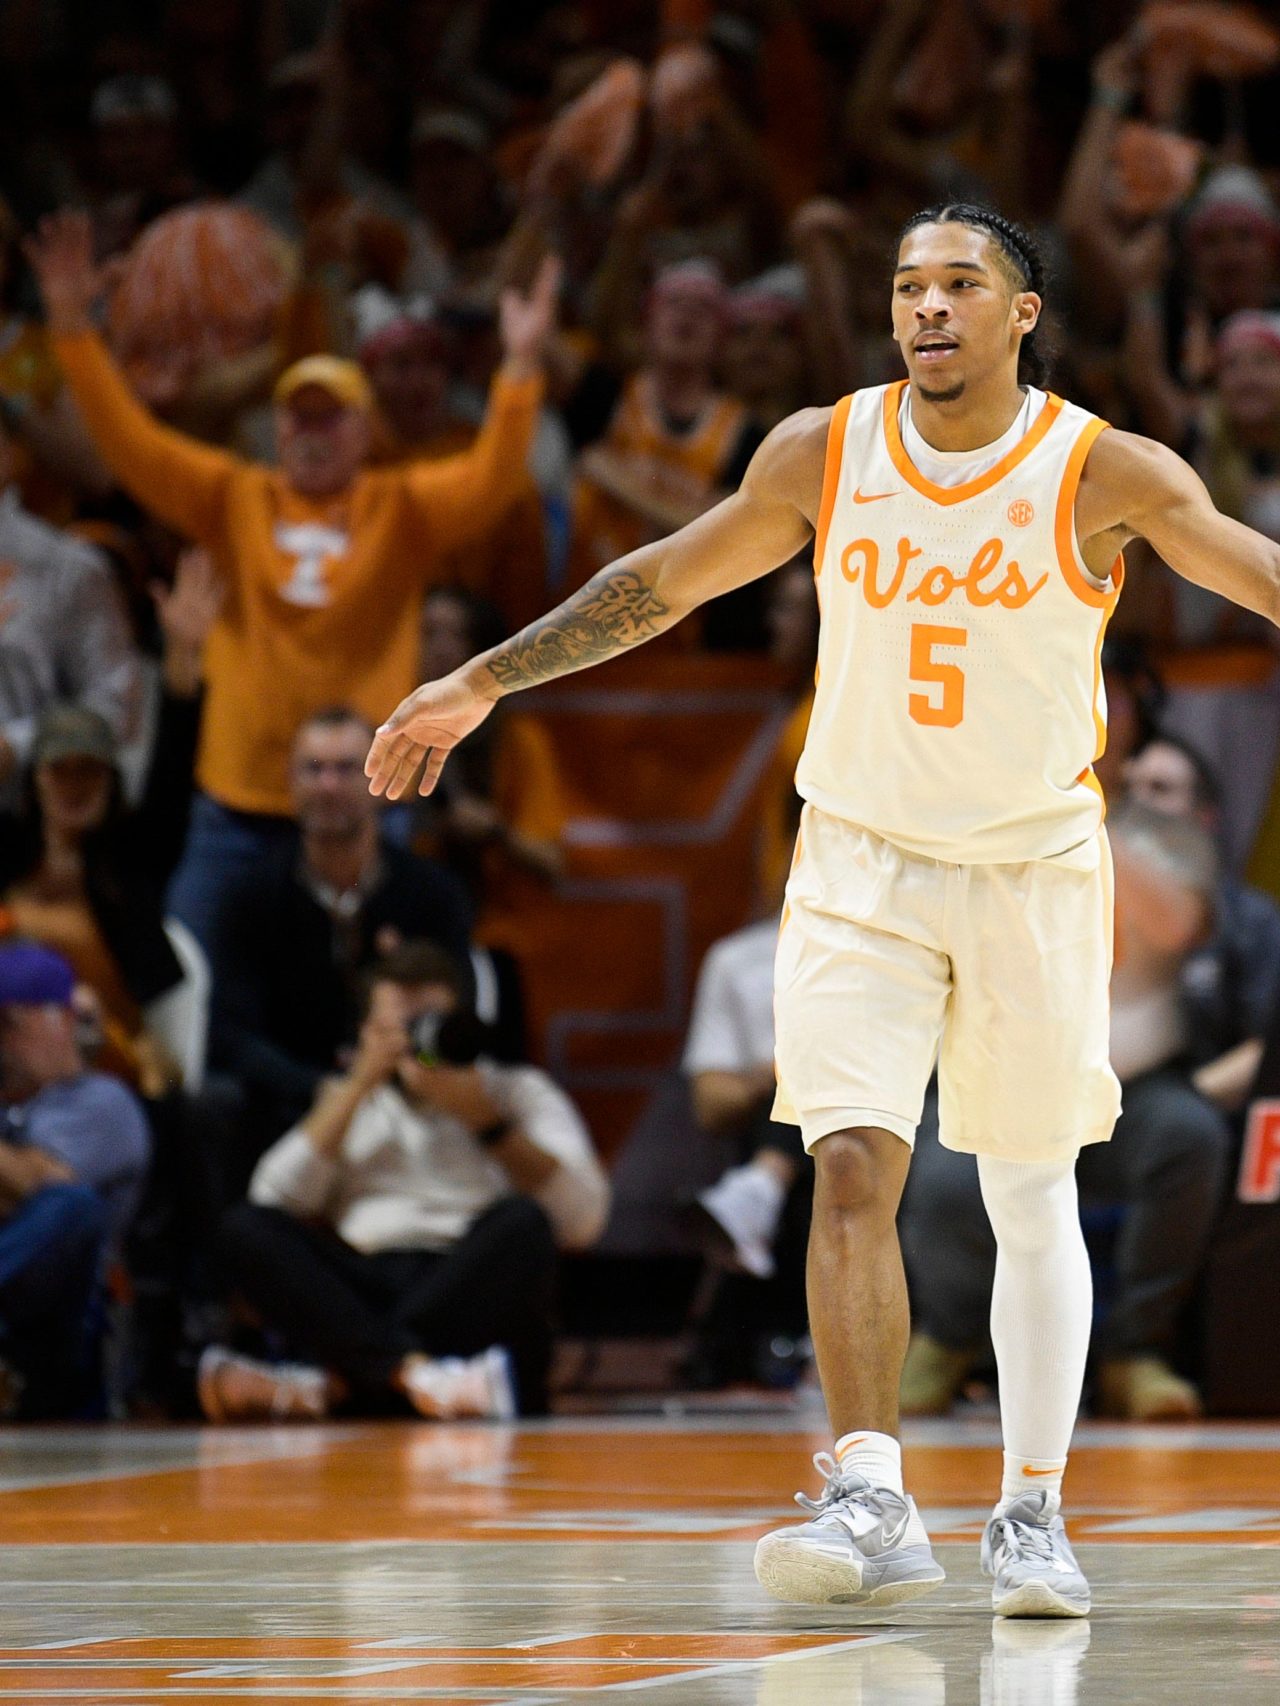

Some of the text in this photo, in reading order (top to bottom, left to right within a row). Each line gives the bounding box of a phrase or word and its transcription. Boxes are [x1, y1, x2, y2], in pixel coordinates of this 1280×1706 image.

[1009, 501, 1032, 525] SEC
[841, 537, 1049, 610] Vols
[908, 623, 967, 728] 5
